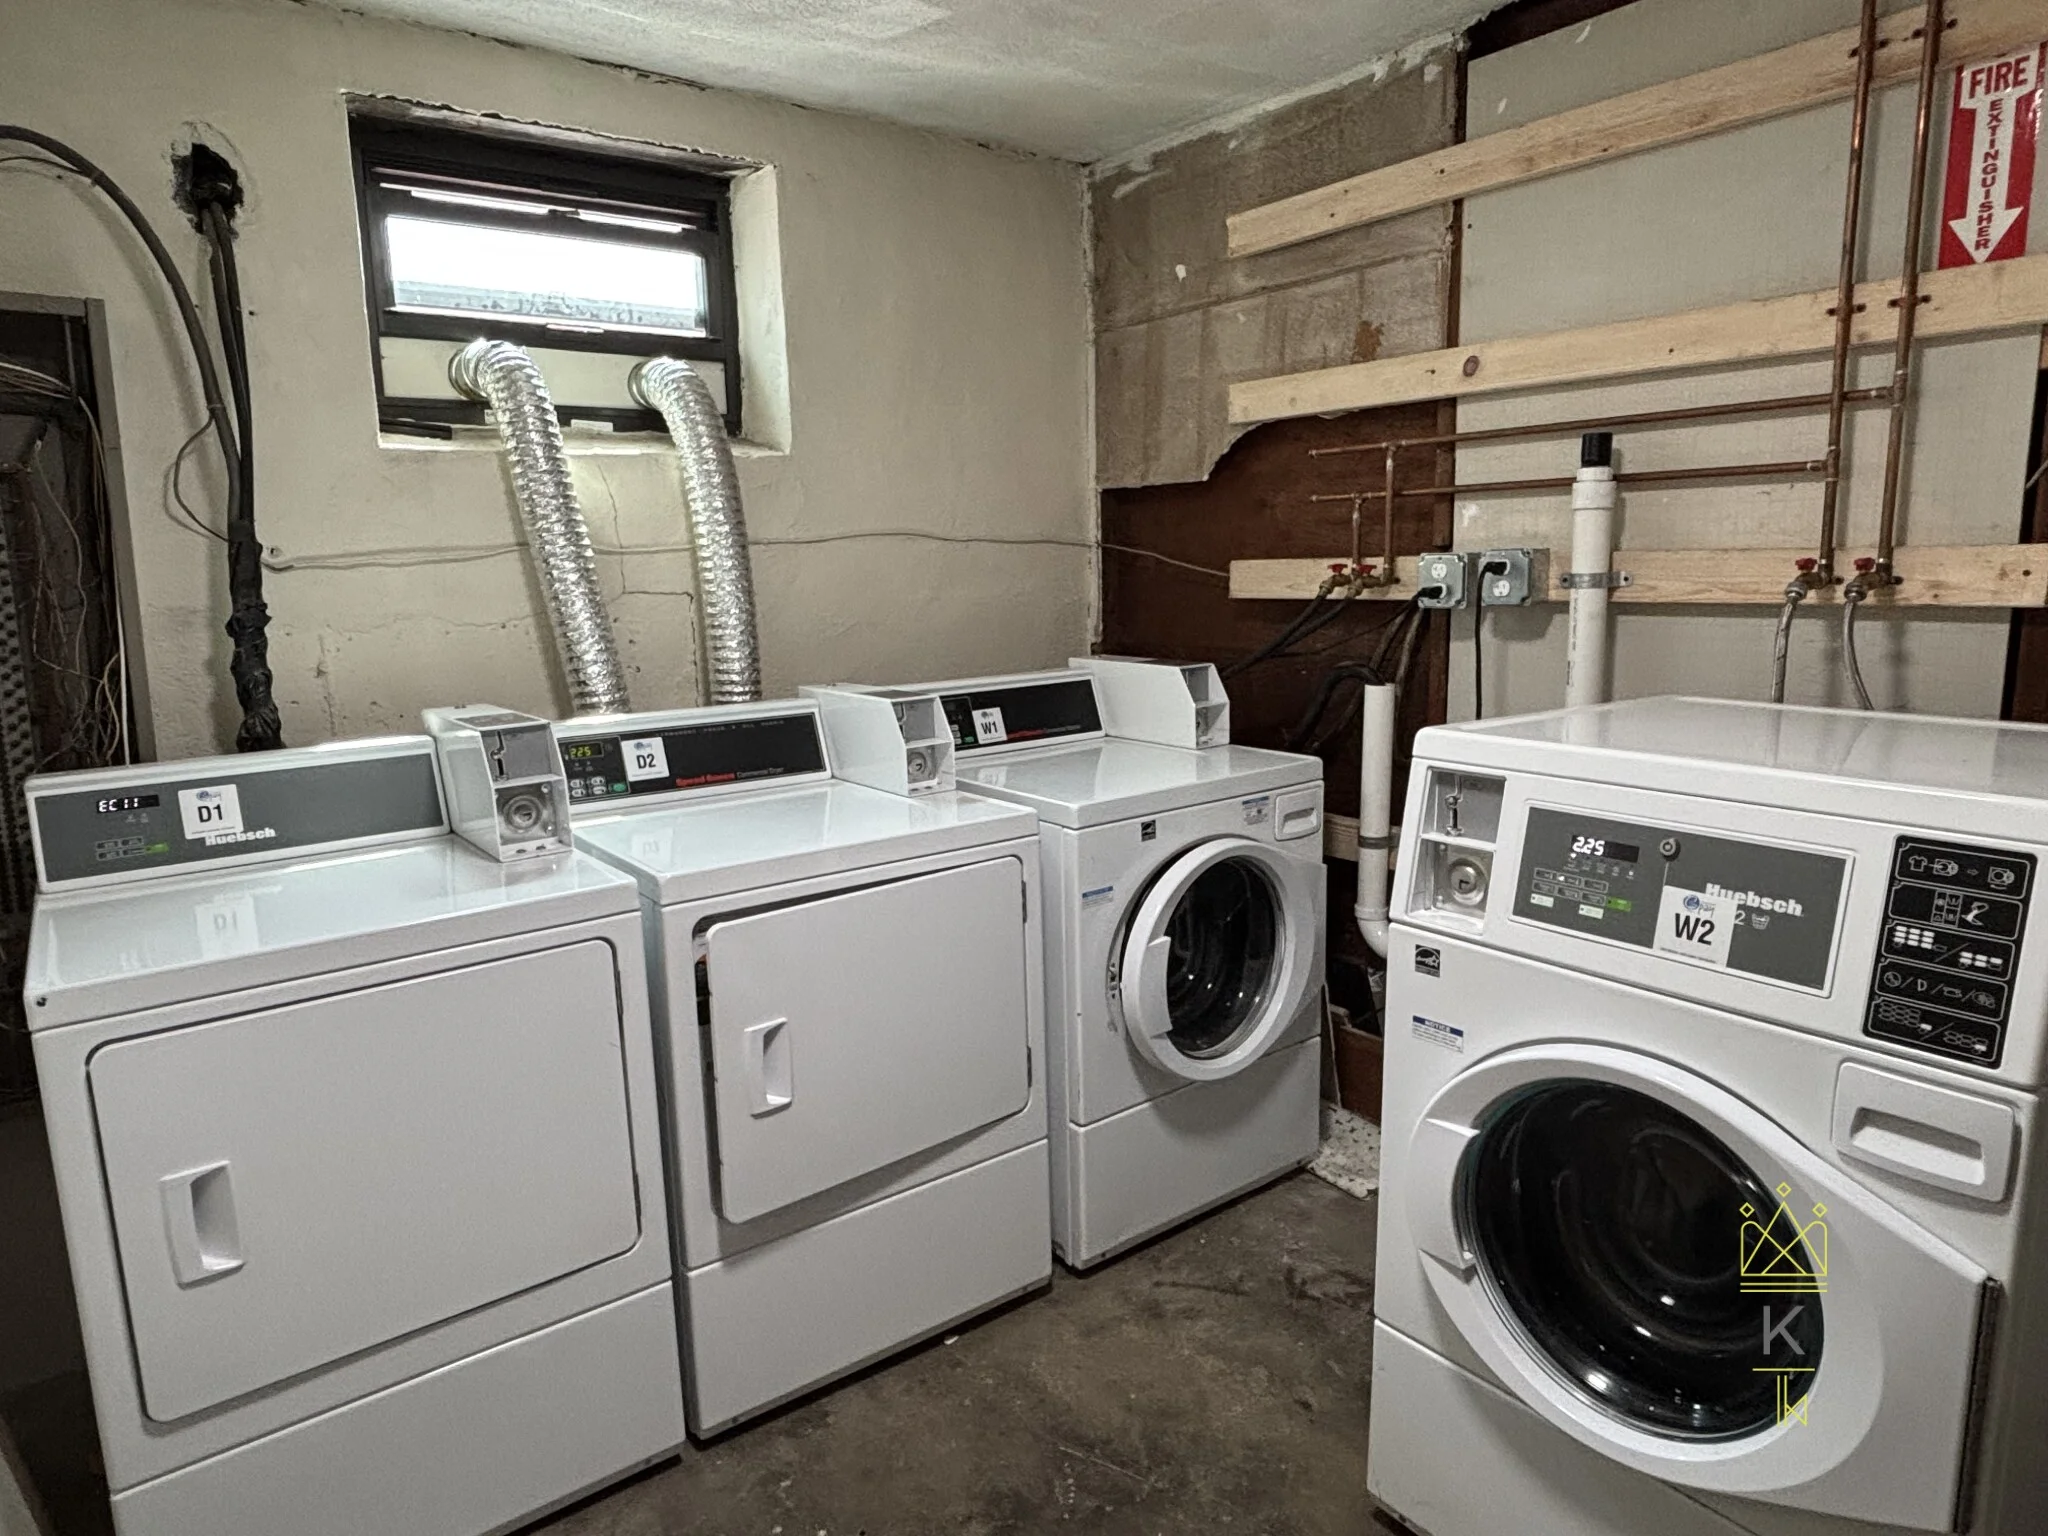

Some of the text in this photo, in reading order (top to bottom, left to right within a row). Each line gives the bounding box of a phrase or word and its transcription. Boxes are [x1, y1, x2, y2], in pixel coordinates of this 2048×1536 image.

[1969, 55, 2031, 99] FIRE
[1974, 98, 2004, 251] EXTINGUISHER
[981, 721, 998, 735] W1
[636, 753, 656, 769] D2
[197, 804, 223, 823] D1
[205, 827, 276, 847] Huebsch
[1705, 882, 1803, 917] Huebsch
[1675, 913, 1715, 946] W2
